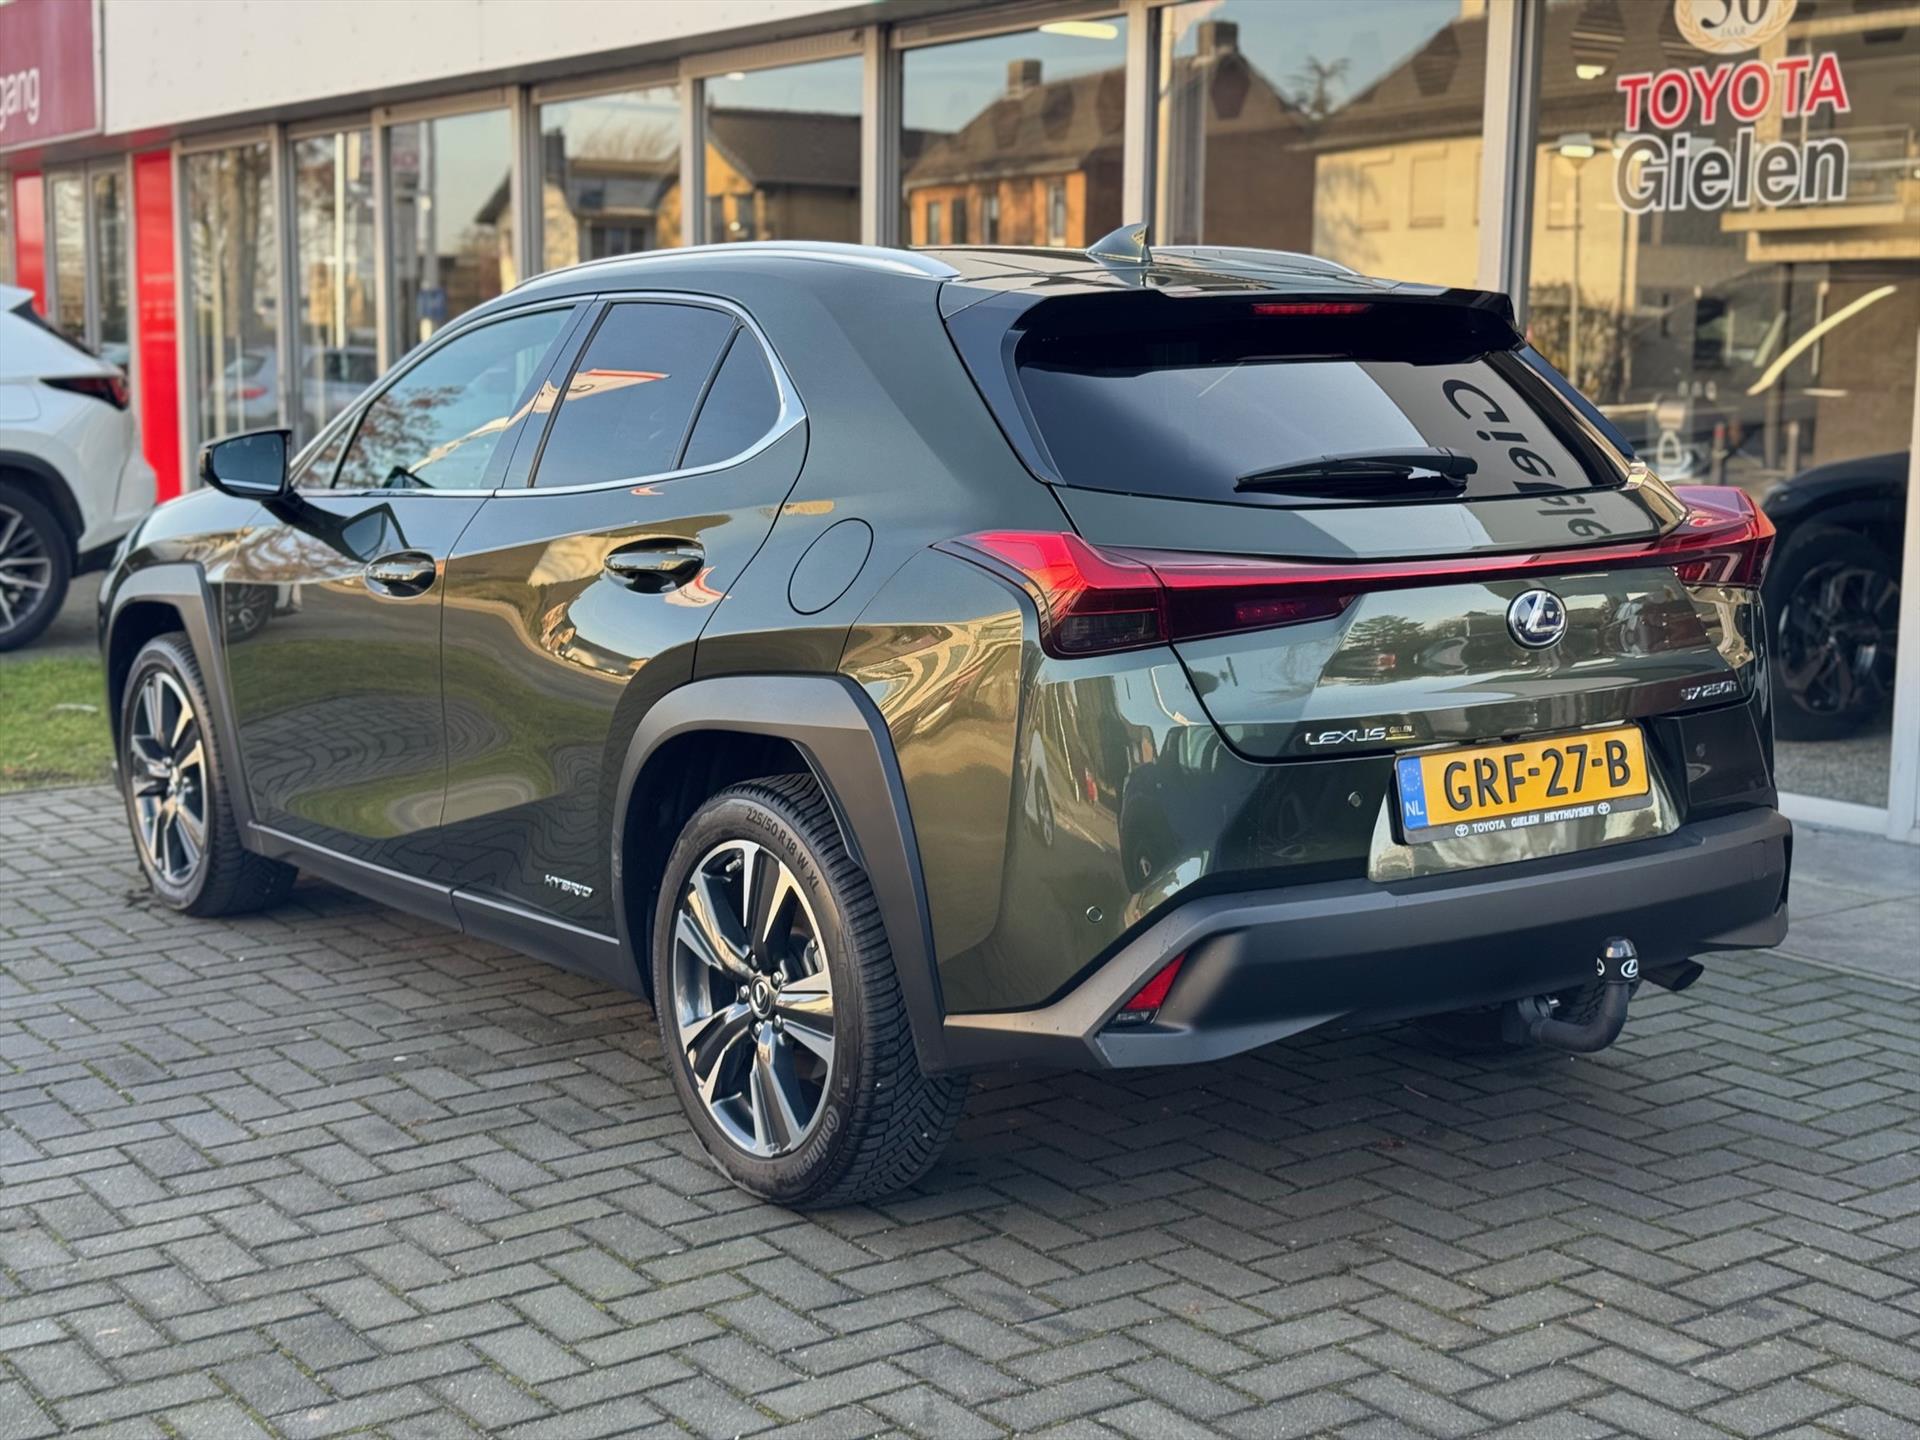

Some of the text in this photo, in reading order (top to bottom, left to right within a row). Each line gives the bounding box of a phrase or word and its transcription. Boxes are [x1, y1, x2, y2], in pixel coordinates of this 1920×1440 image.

[1617, 52, 1850, 131] TOYOTA
[1613, 127, 1849, 214] Gielen
[1304, 727, 1386, 746] LEXUS
[1444, 739, 1631, 812] GRF-27-B
[745, 807, 779, 837] 225/50
[777, 829, 787, 846] R
[786, 838, 798, 856] 18
[1405, 800, 1425, 817] NL
[1472, 819, 1507, 834] TOYOTA
[1511, 813, 1540, 828] GIELEN
